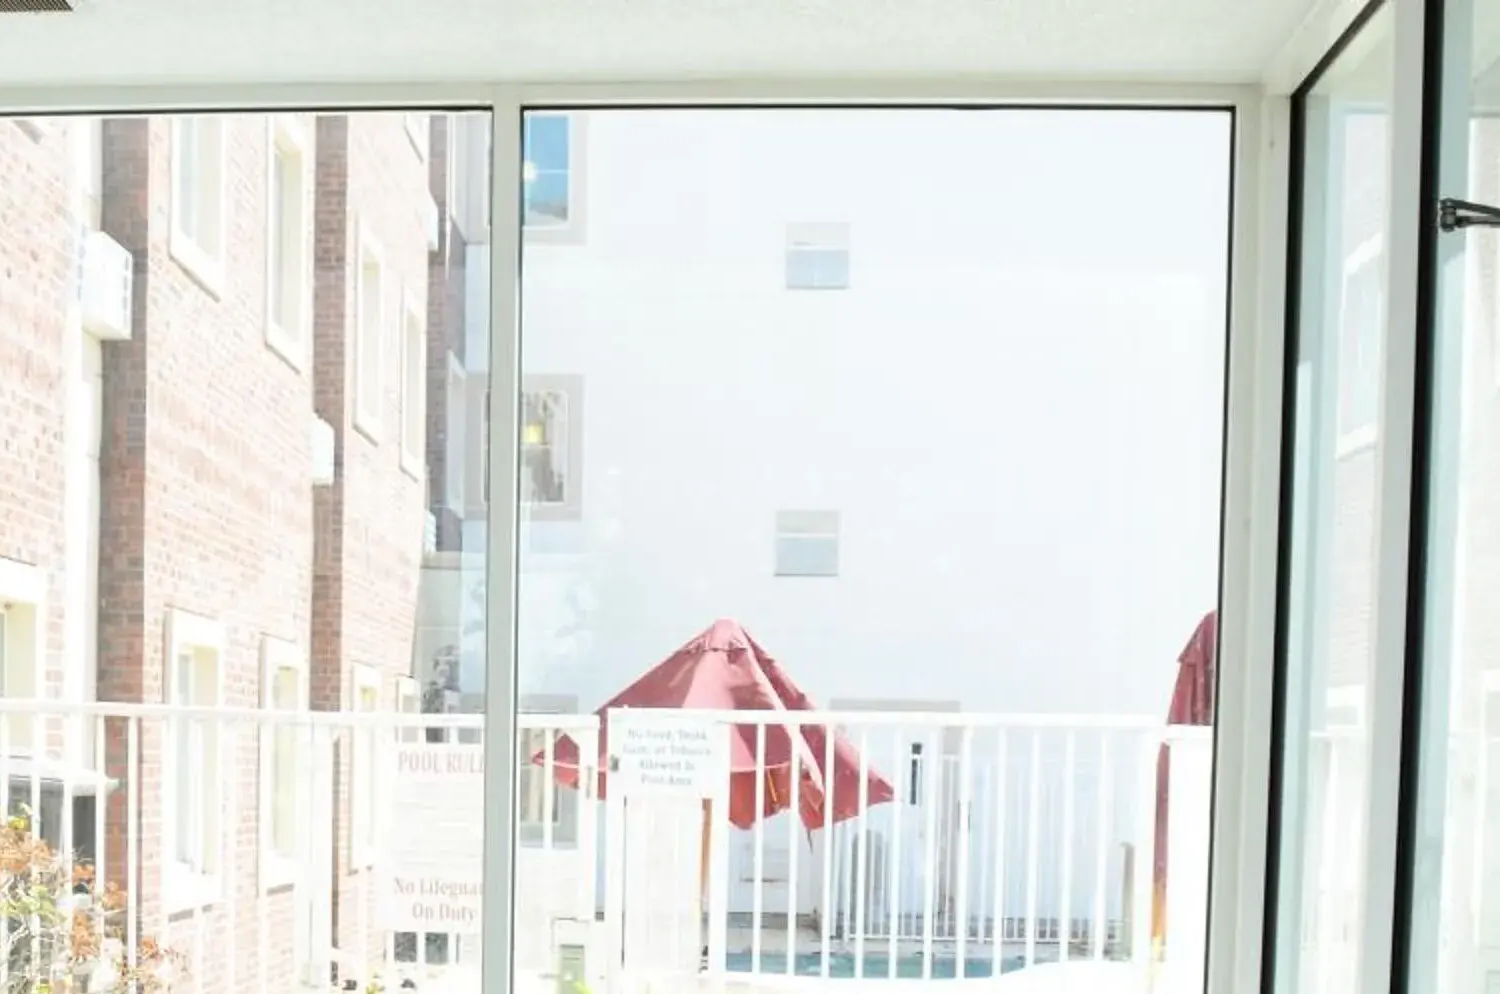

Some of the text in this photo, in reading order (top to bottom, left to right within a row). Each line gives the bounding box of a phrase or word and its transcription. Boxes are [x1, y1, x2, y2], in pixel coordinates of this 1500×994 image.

[628, 728, 643, 740] No
[397, 751, 440, 774] POOL
[639, 758, 681, 770] Allowed
[640, 773, 665, 785] Pool
[394, 876, 415, 895] No
[411, 902, 476, 925] On Duty
